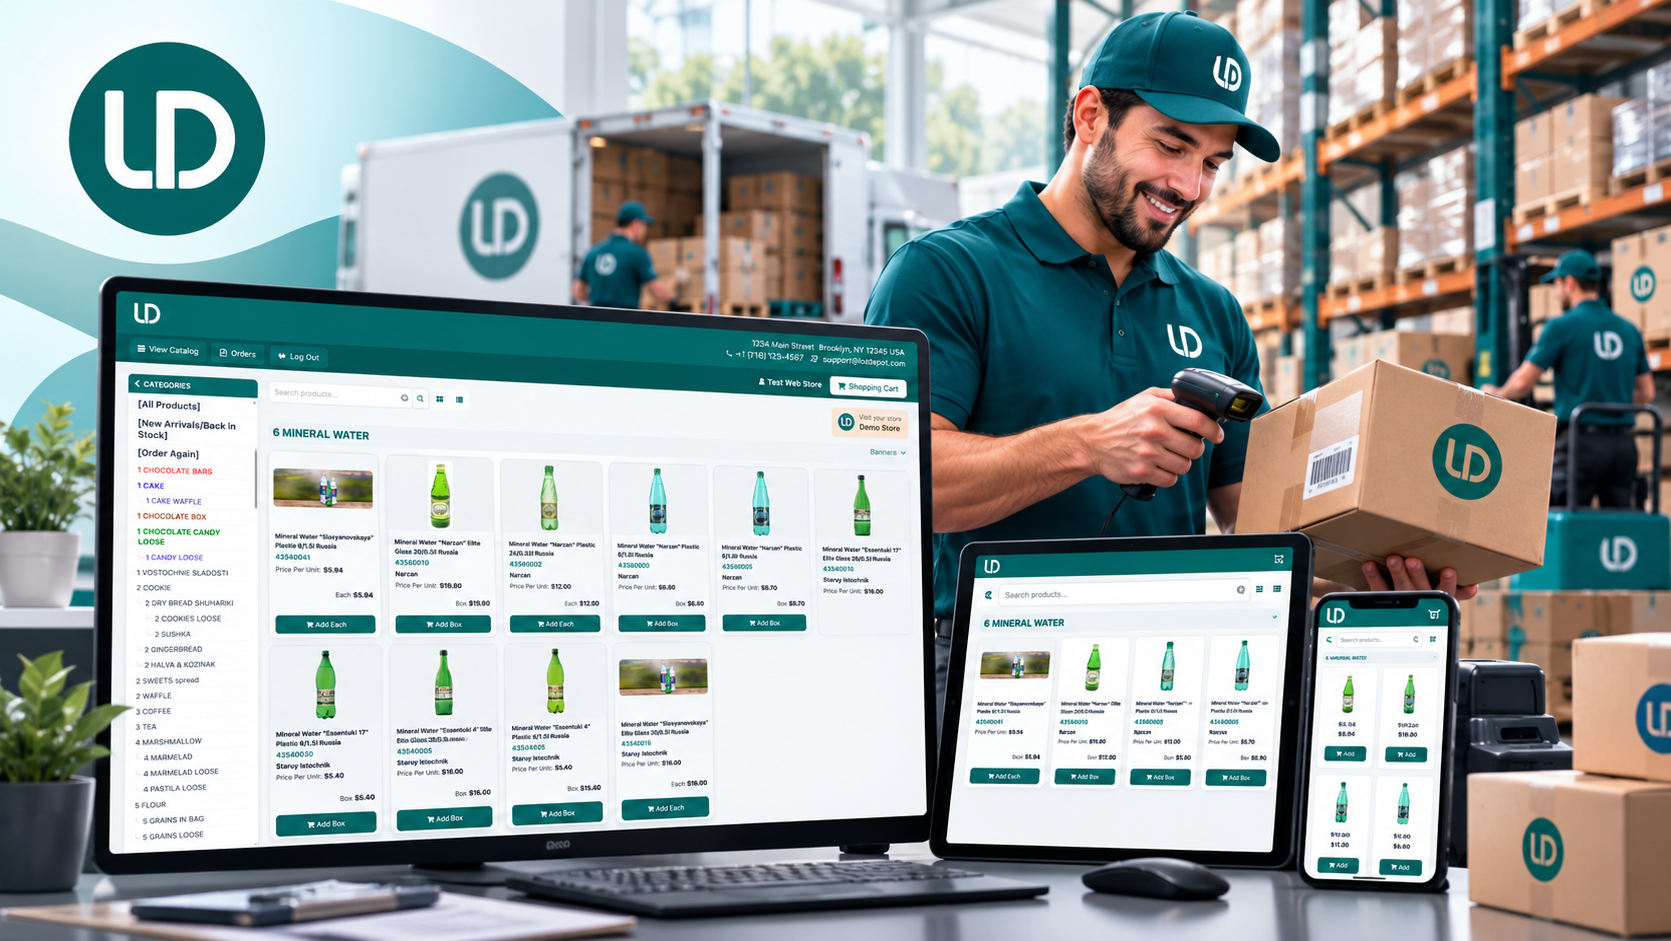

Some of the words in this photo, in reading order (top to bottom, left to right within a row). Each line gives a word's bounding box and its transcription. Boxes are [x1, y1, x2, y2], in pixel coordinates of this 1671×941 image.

[169, 347, 199, 356] Catalog
[771, 341, 789, 349] Main
[890, 348, 905, 356] USA
[231, 349, 256, 358] Orders
[290, 353, 303, 362] Log
[304, 353, 320, 361] Out
[143, 381, 191, 389] CATEGORIES
[849, 383, 882, 392] Shopping
[274, 388, 298, 397] Search
[138, 400, 154, 410] [All
[156, 401, 201, 411] Products]
[138, 419, 162, 429] [New
[163, 420, 226, 431] Arrivals/Back
[228, 422, 236, 430] in
[138, 430, 168, 440] Stock]
[272, 428, 280, 437] 6
[282, 428, 330, 439] MINERAL
[332, 430, 370, 440] WATER
[138, 448, 167, 459] [Order
[168, 449, 199, 459] Again]
[1005, 591, 1030, 599] Search
[984, 619, 990, 627] 6
[992, 619, 1032, 628] MINERAL
[1034, 618, 1064, 627] WATER
